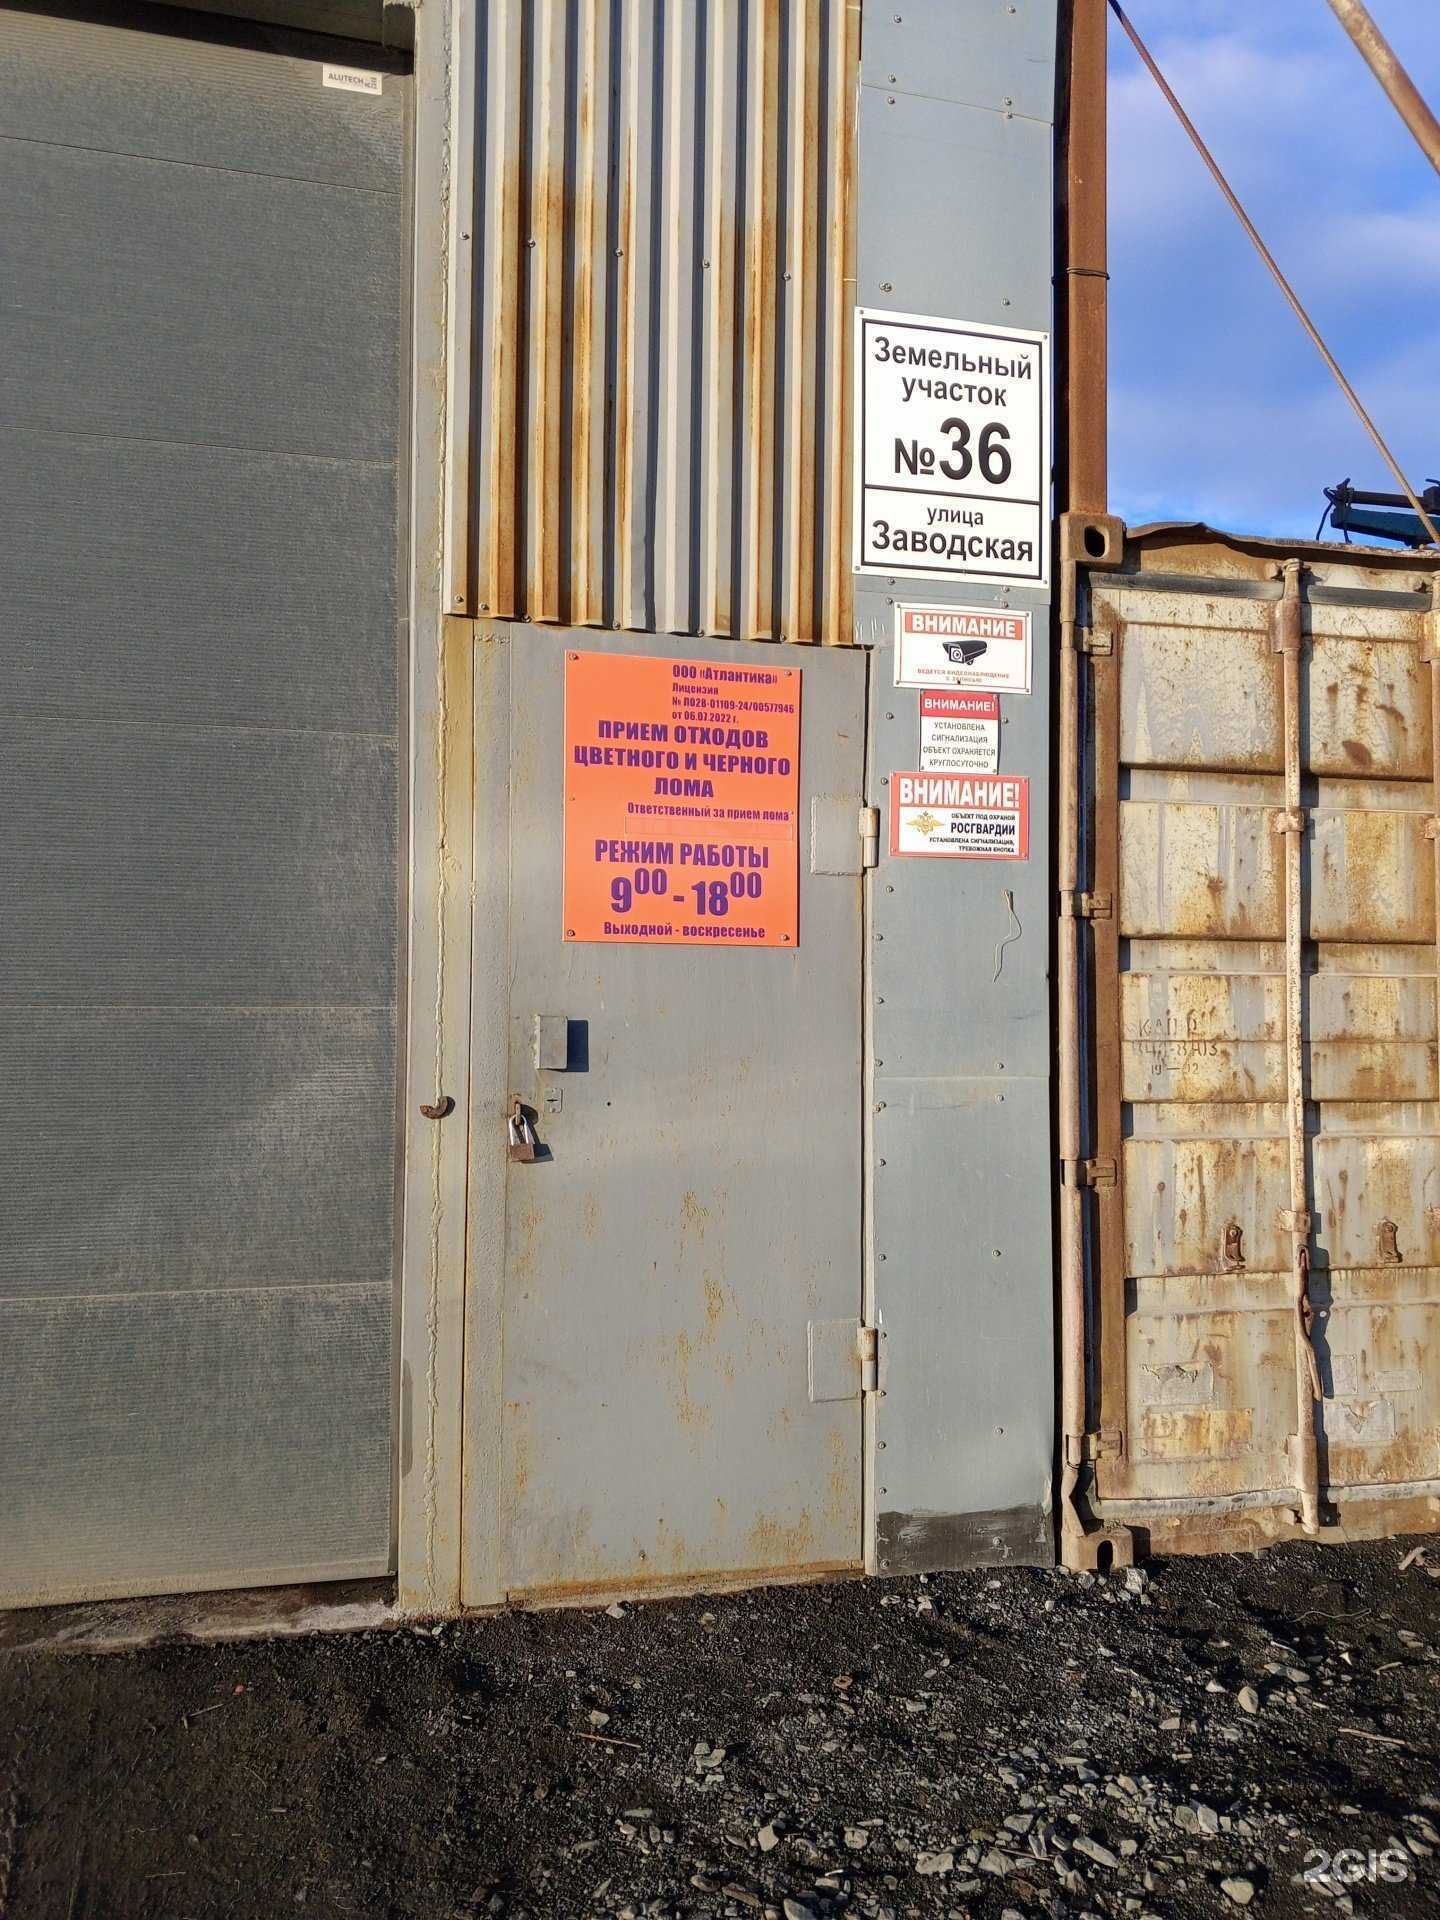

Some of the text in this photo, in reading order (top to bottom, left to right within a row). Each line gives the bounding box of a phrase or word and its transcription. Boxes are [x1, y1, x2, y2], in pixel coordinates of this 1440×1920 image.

[328, 72, 363, 84] ALUTECH
[874, 336, 1032, 379] Земельный
[902, 376, 1007, 406] участок
[927, 507, 984, 527] улица
[872, 520, 1033, 561] Заводская
[912, 614, 1016, 638] ВНИМАНИЕ
[672, 665, 777, 684] ООО «Атлантика»
[672, 683, 718, 695] Лицензия
[924, 698, 995, 712] ВНИМАНИЕ!
[684, 711, 730, 723] 06.07.2022
[934, 722, 985, 731] УСТАНОВЛЕНА
[598, 720, 768, 749] ПРИЕМ ОТХОДОВ
[931, 734, 988, 744] СИГНАЛИЗАЦИЯ
[574, 745, 790, 775] ЦВЕТНОГО И ЧЕРНОГО
[923, 746, 996, 756] ОБЪЕКТ ОХРАНЯЕТСЯ
[929, 759, 989, 768] КРУГЛОСУТОЧНО
[654, 777, 714, 798] ЛОМА
[900, 777, 1020, 808] ВНИМАНИЕ!
[627, 802, 789, 821] Ответственный за прием лома
[951, 823, 1015, 836] РОСГВАРДИИ
[595, 839, 769, 868] РЕЖИМ РАБОТЫ
[603, 922, 672, 937] Выходной
[682, 926, 765, 938] воскресенье
